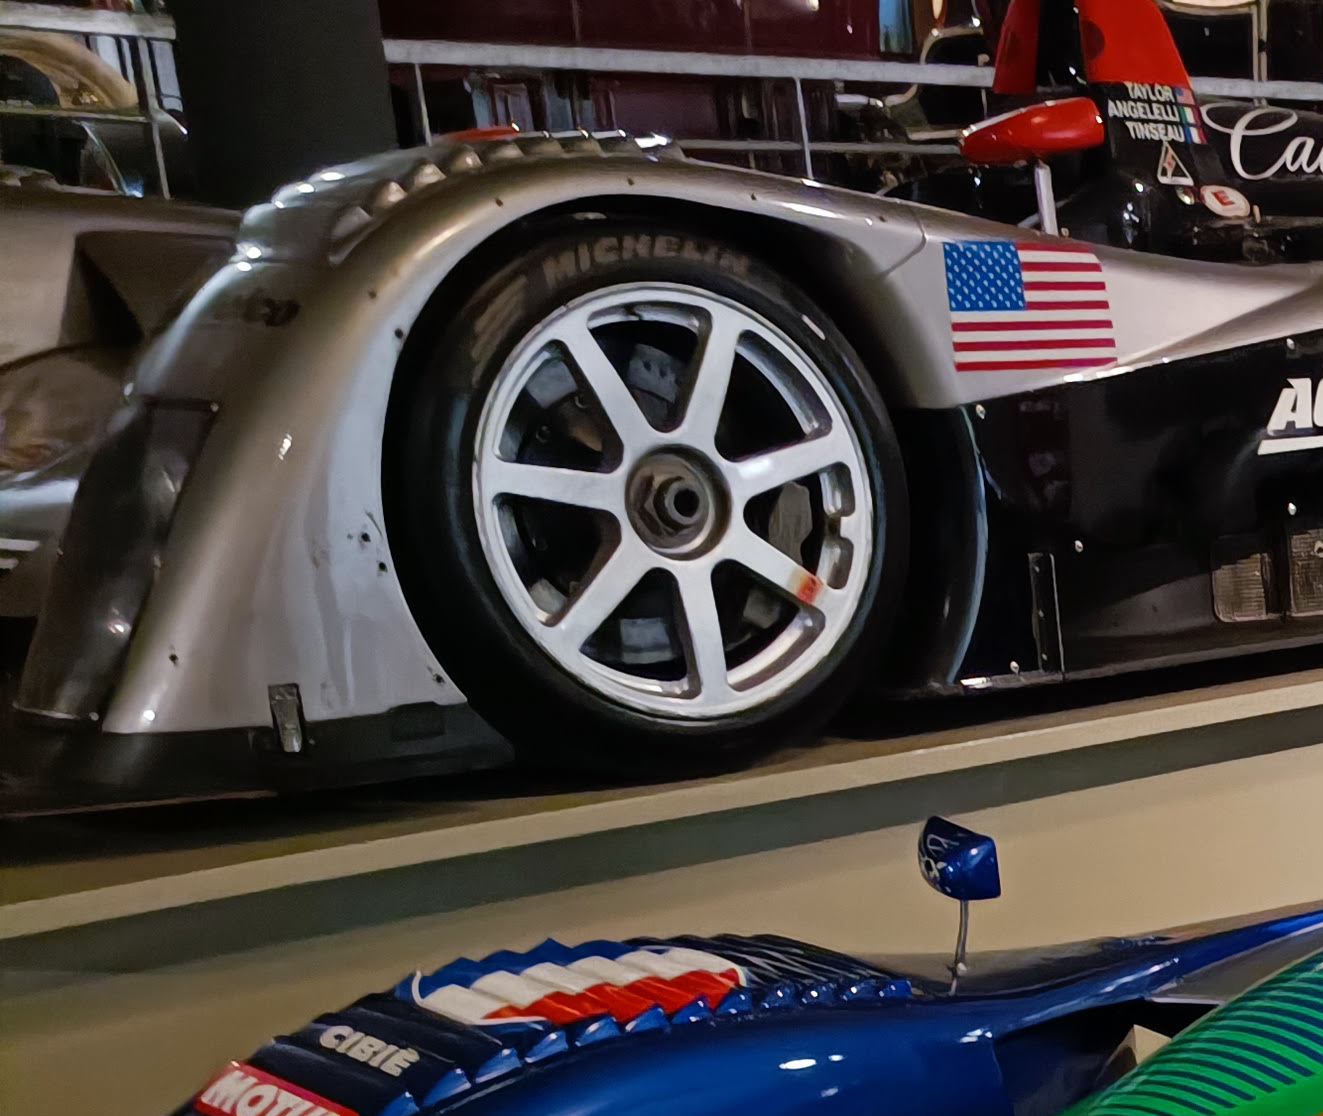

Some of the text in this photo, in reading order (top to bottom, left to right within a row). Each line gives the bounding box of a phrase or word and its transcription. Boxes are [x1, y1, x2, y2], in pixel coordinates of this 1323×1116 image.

[1124, 81, 1175, 102] TAYLOR
[1108, 97, 1180, 122] ANGELELLI
[1124, 120, 1185, 142] TINSEAU
